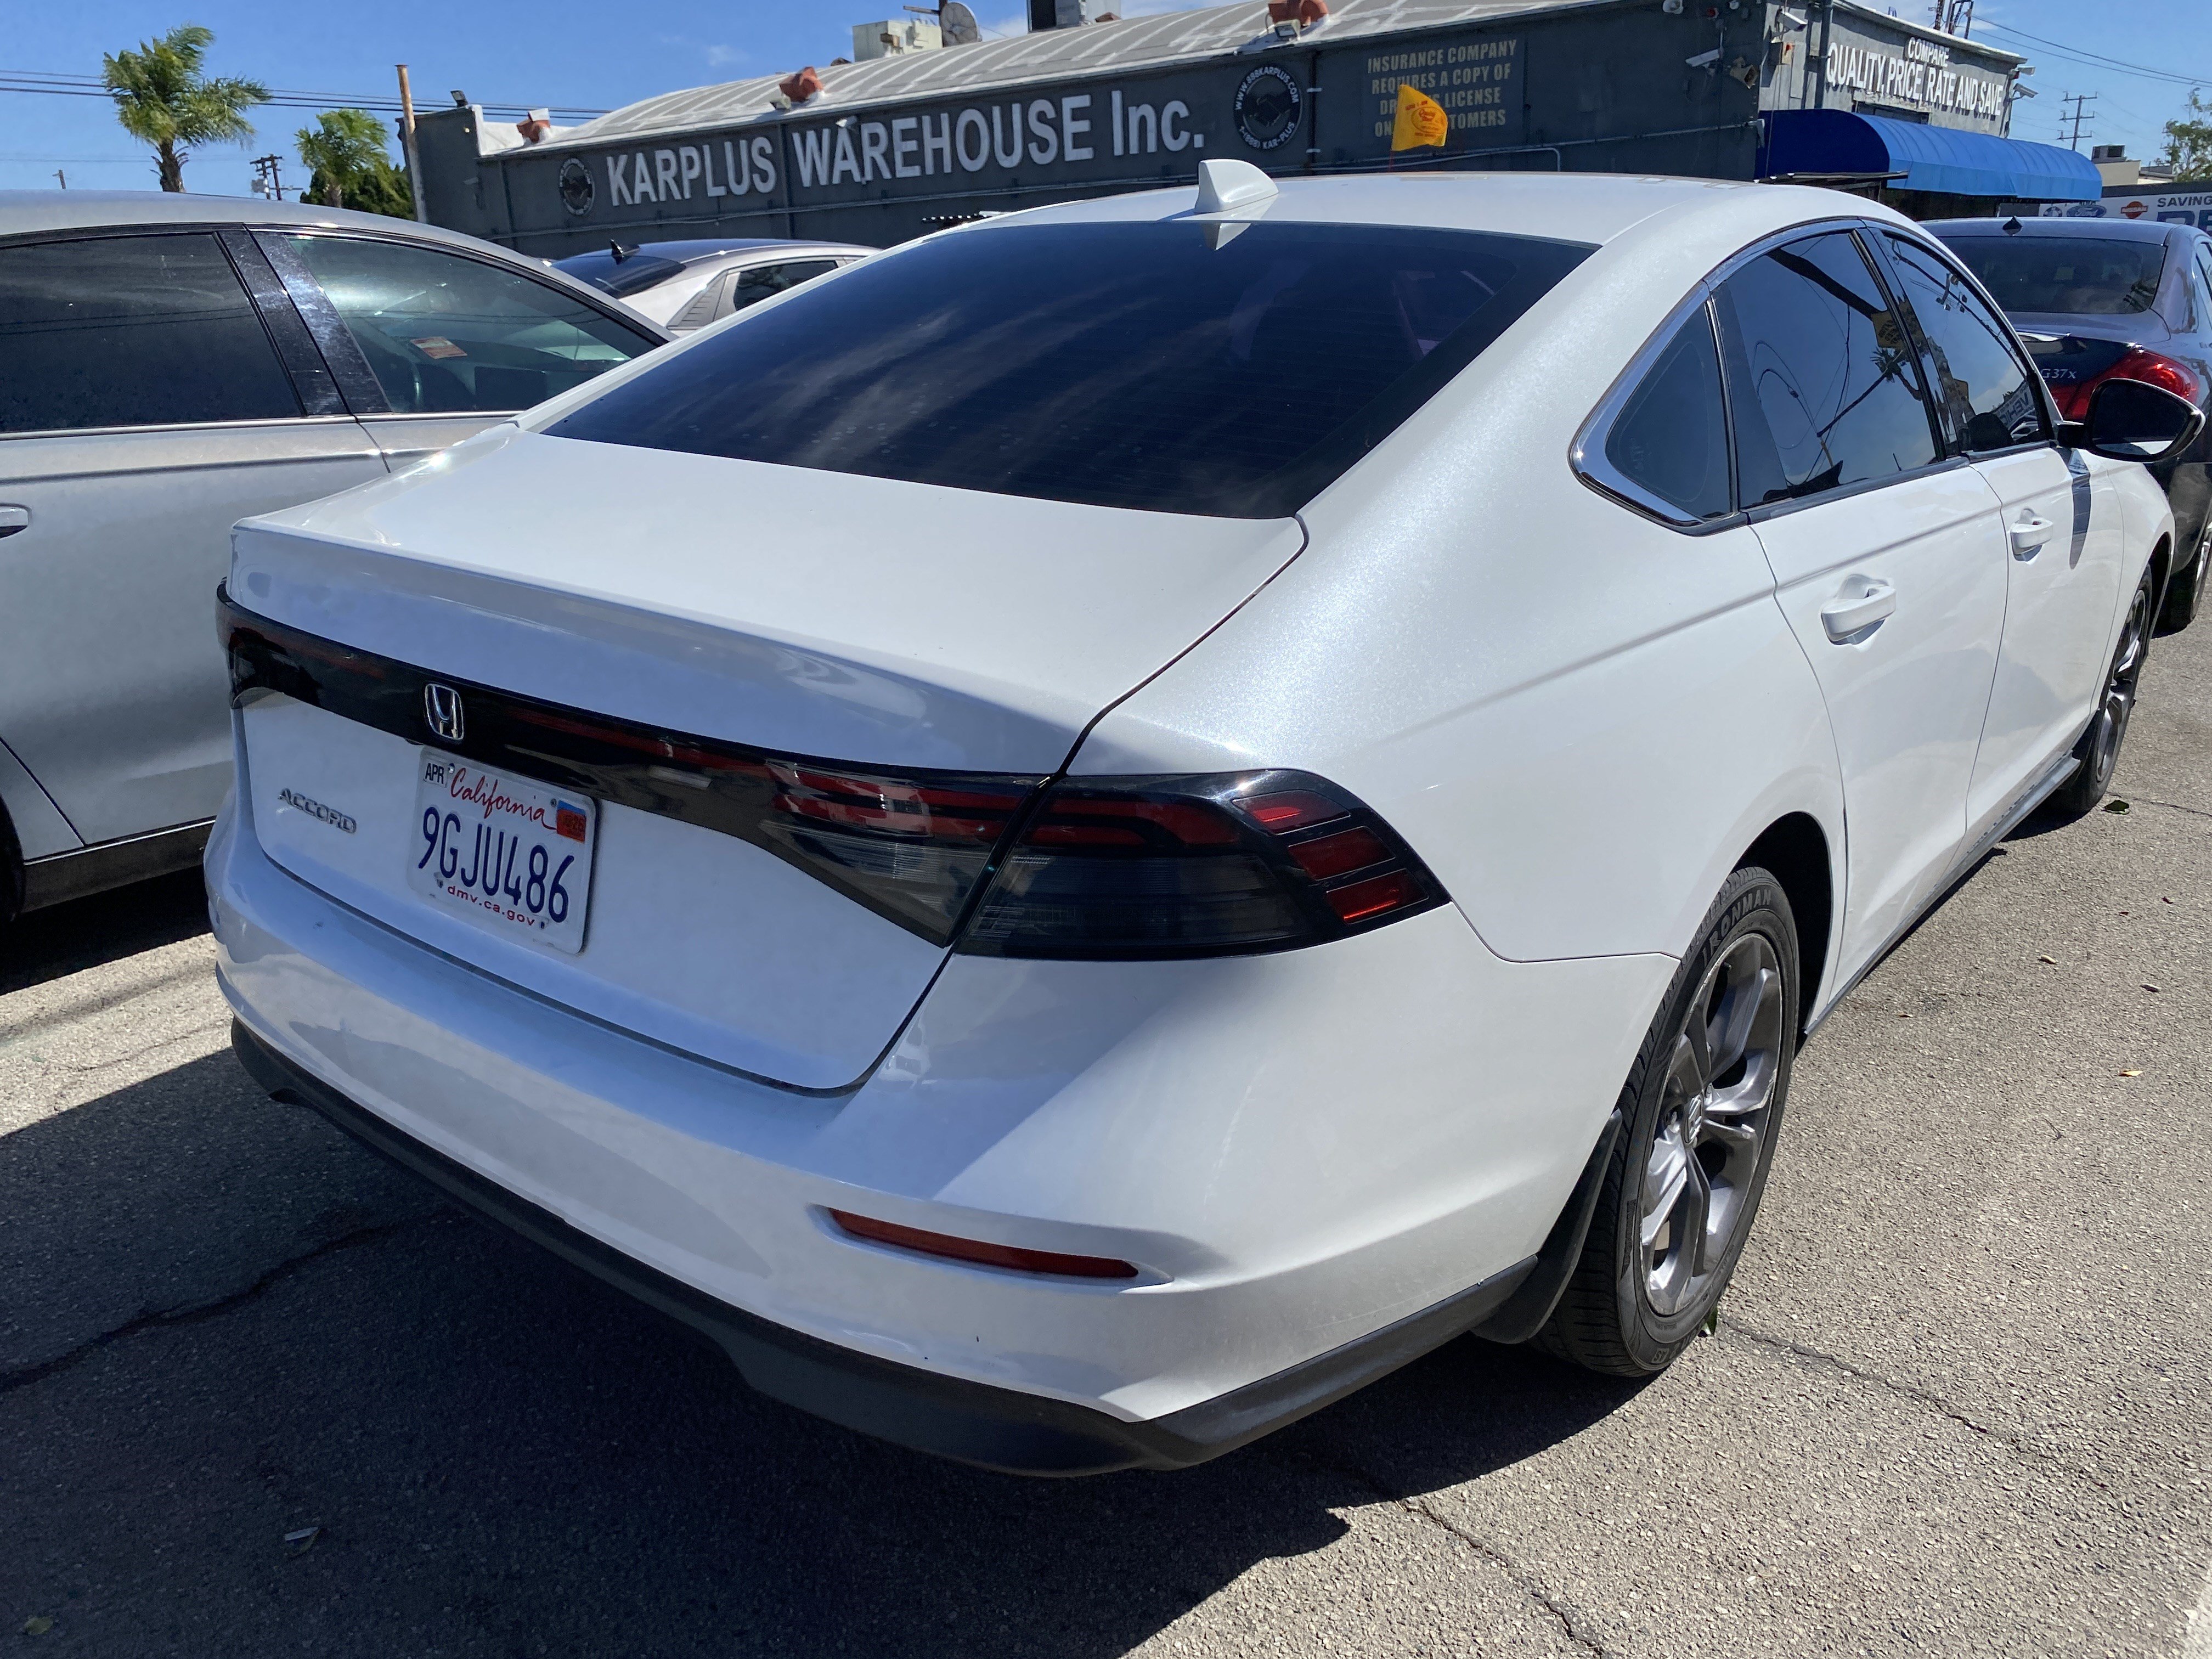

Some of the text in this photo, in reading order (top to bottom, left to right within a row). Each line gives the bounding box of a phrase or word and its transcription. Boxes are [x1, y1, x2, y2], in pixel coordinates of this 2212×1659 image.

[1368, 40, 1517, 74] INSURANCE COMPANY
[1908, 37, 1950, 67] COMPARE
[1440, 71, 1448, 87] A
[1453, 65, 1489, 86] COPY
[1494, 63, 1511, 81] OF
[1926, 66, 1956, 106] RATE
[1955, 75, 1978, 110] AND
[1978, 81, 2004, 116] SAVE
[1444, 87, 1501, 108] LICENSE
[1449, 109, 1506, 130] TOMERS
[606, 137, 777, 206] KARPLUS
[792, 94, 1094, 188] WAREHOUSE
[1111, 90, 1204, 156] Inc.
[278, 788, 357, 834] ACCORD
[425, 763, 444, 785] APR
[450, 768, 557, 830] California
[418, 806, 575, 923] 9GJU486
[447, 885, 535, 926] dmv.ca.gov
[1702, 889, 1771, 967] IRONMAN
